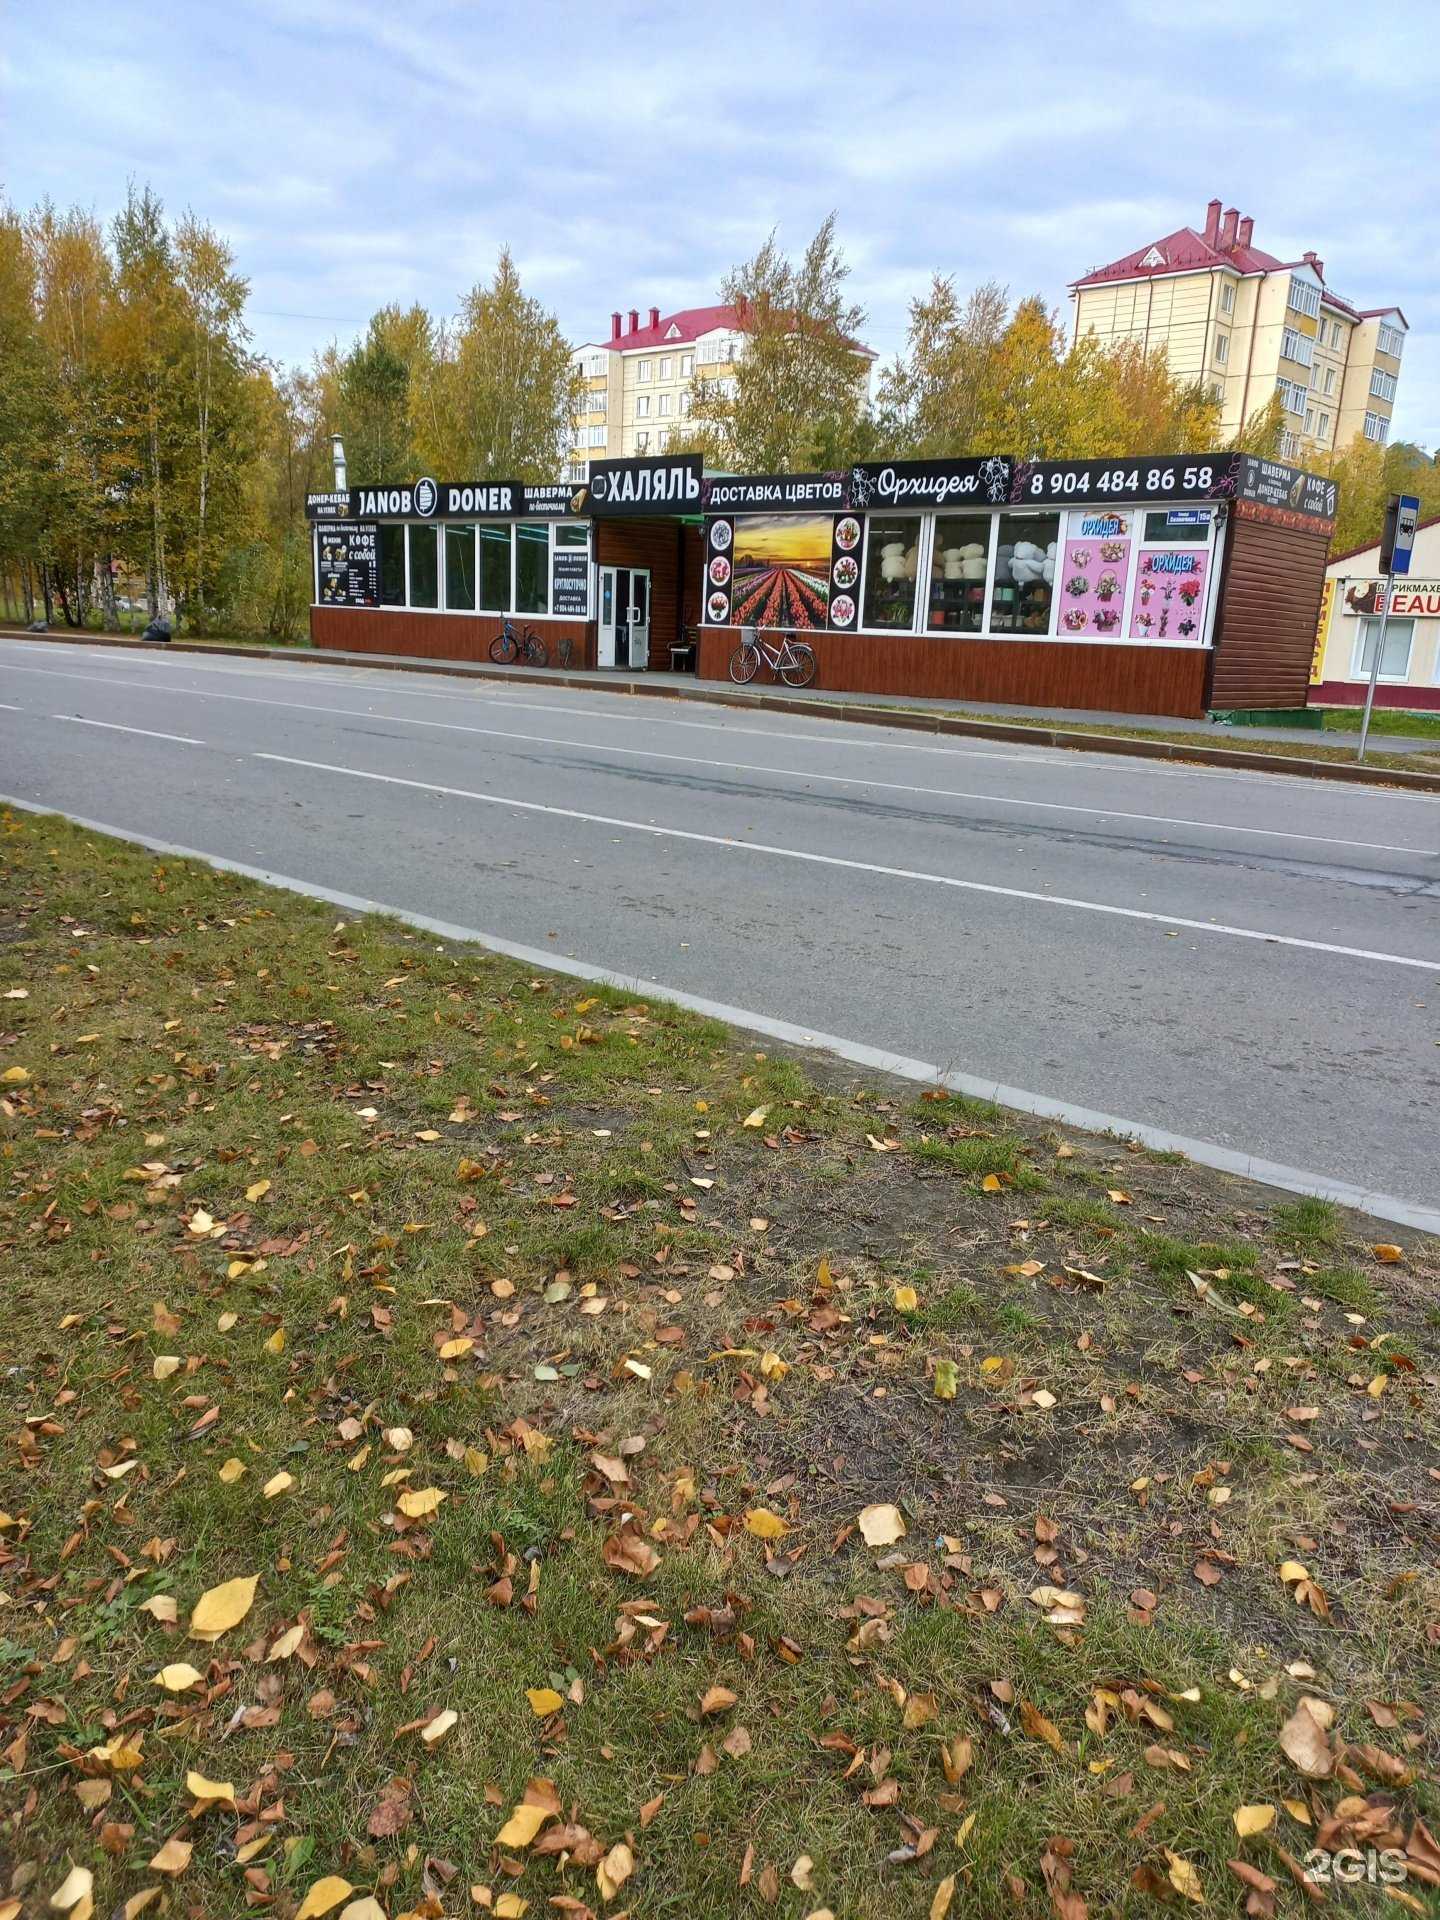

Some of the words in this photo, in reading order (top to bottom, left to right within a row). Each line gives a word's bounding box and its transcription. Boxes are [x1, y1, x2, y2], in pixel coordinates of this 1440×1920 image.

[1030, 473, 1044, 495] 8
[1050, 471, 1090, 495] 904
[1097, 470, 1139, 493] 484
[1146, 468, 1176, 491] 86
[1182, 467, 1213, 490] 58
[1261, 462, 1291, 482] ШАВЕРМА
[524, 486, 573, 499] ШАВЕРМА
[607, 467, 700, 502] ХАЛЯЛЬ
[710, 484, 782, 505] ДОСТАВКА
[785, 482, 842, 502] ЦВЕТОВ
[877, 468, 979, 504] Орхидея
[307, 493, 350, 506] ДОНЕР-КЕБАБ
[359, 490, 412, 515] JANOB
[448, 487, 513, 512] DONER
[1081, 518, 1120, 539] ОРХИДЕЯ
[349, 534, 375, 547] КОФЕ
[353, 547, 377, 561] собой
[1151, 552, 1194, 575] ОРХИДЕЯ
